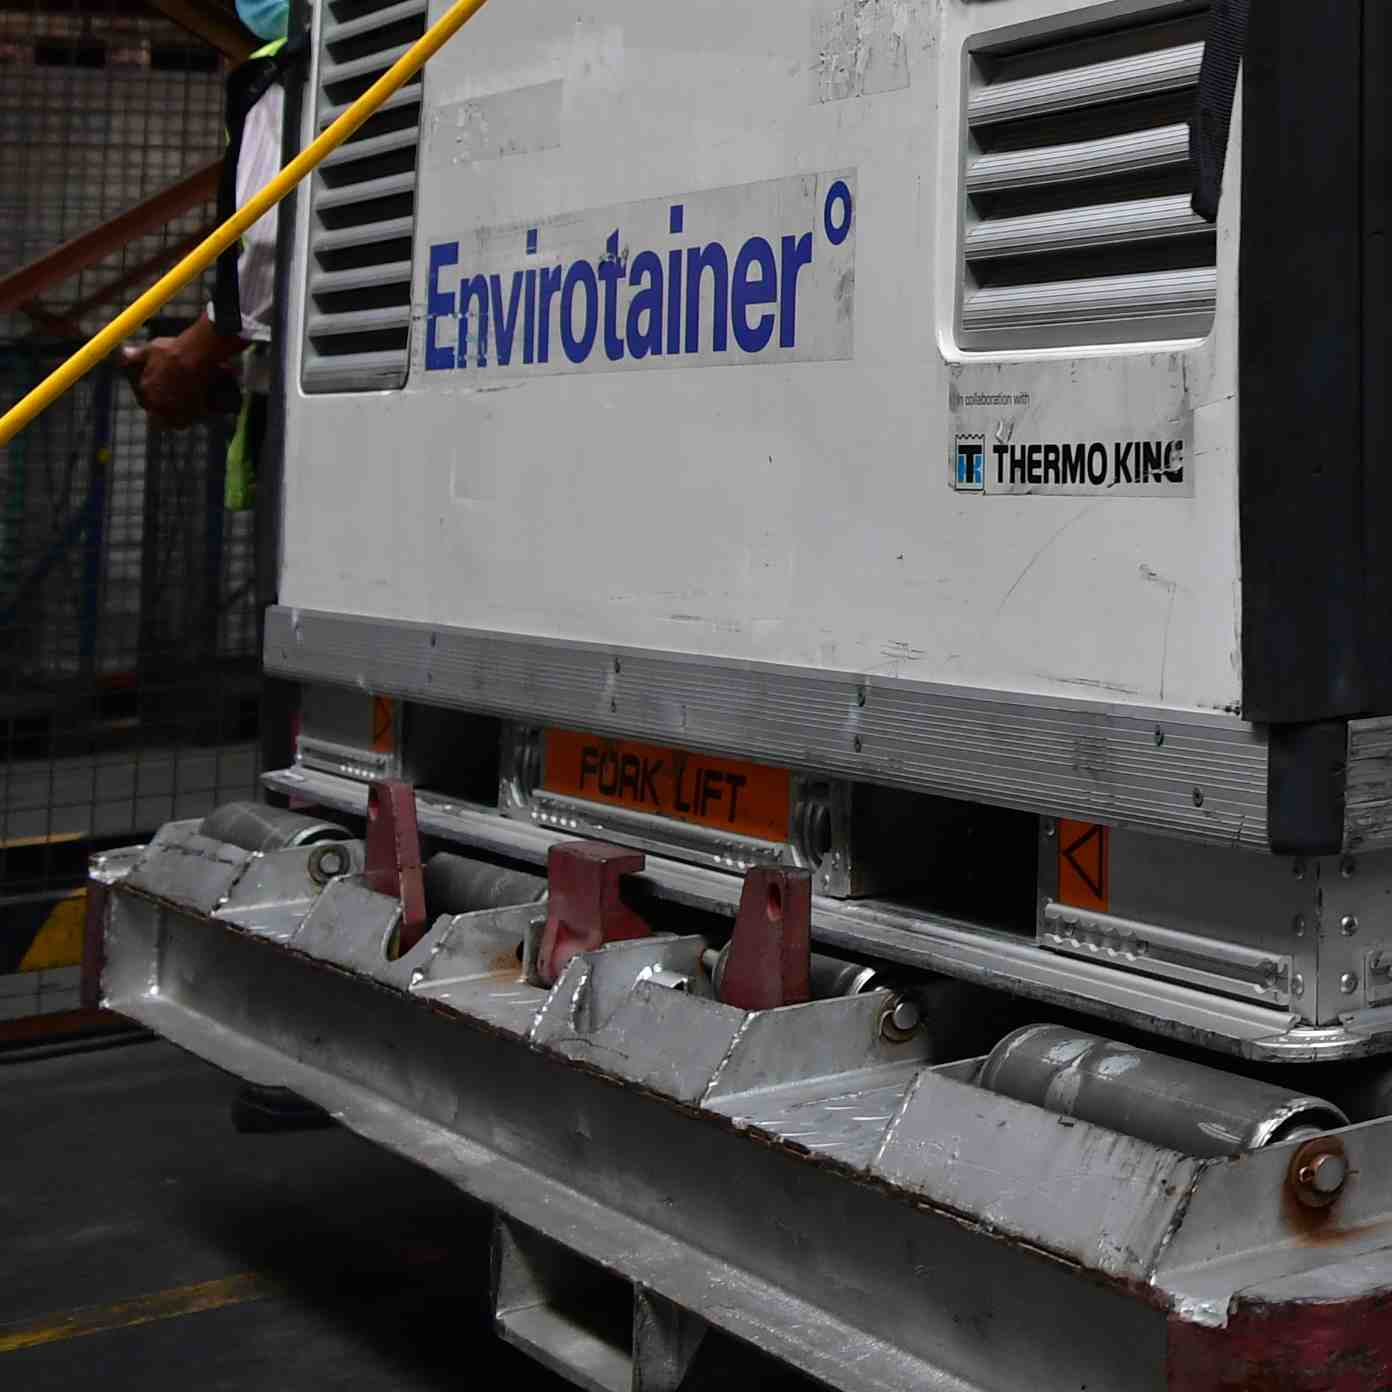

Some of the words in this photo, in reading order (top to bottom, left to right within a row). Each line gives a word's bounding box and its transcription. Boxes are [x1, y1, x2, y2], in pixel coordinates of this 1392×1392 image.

[965, 391, 1013, 406] collaboration
[1013, 391, 1032, 408] with
[992, 441, 1109, 486] THERMO
[1113, 439, 1184, 484] KING
[578, 745, 664, 807] FORK
[673, 767, 748, 824] LIFT
